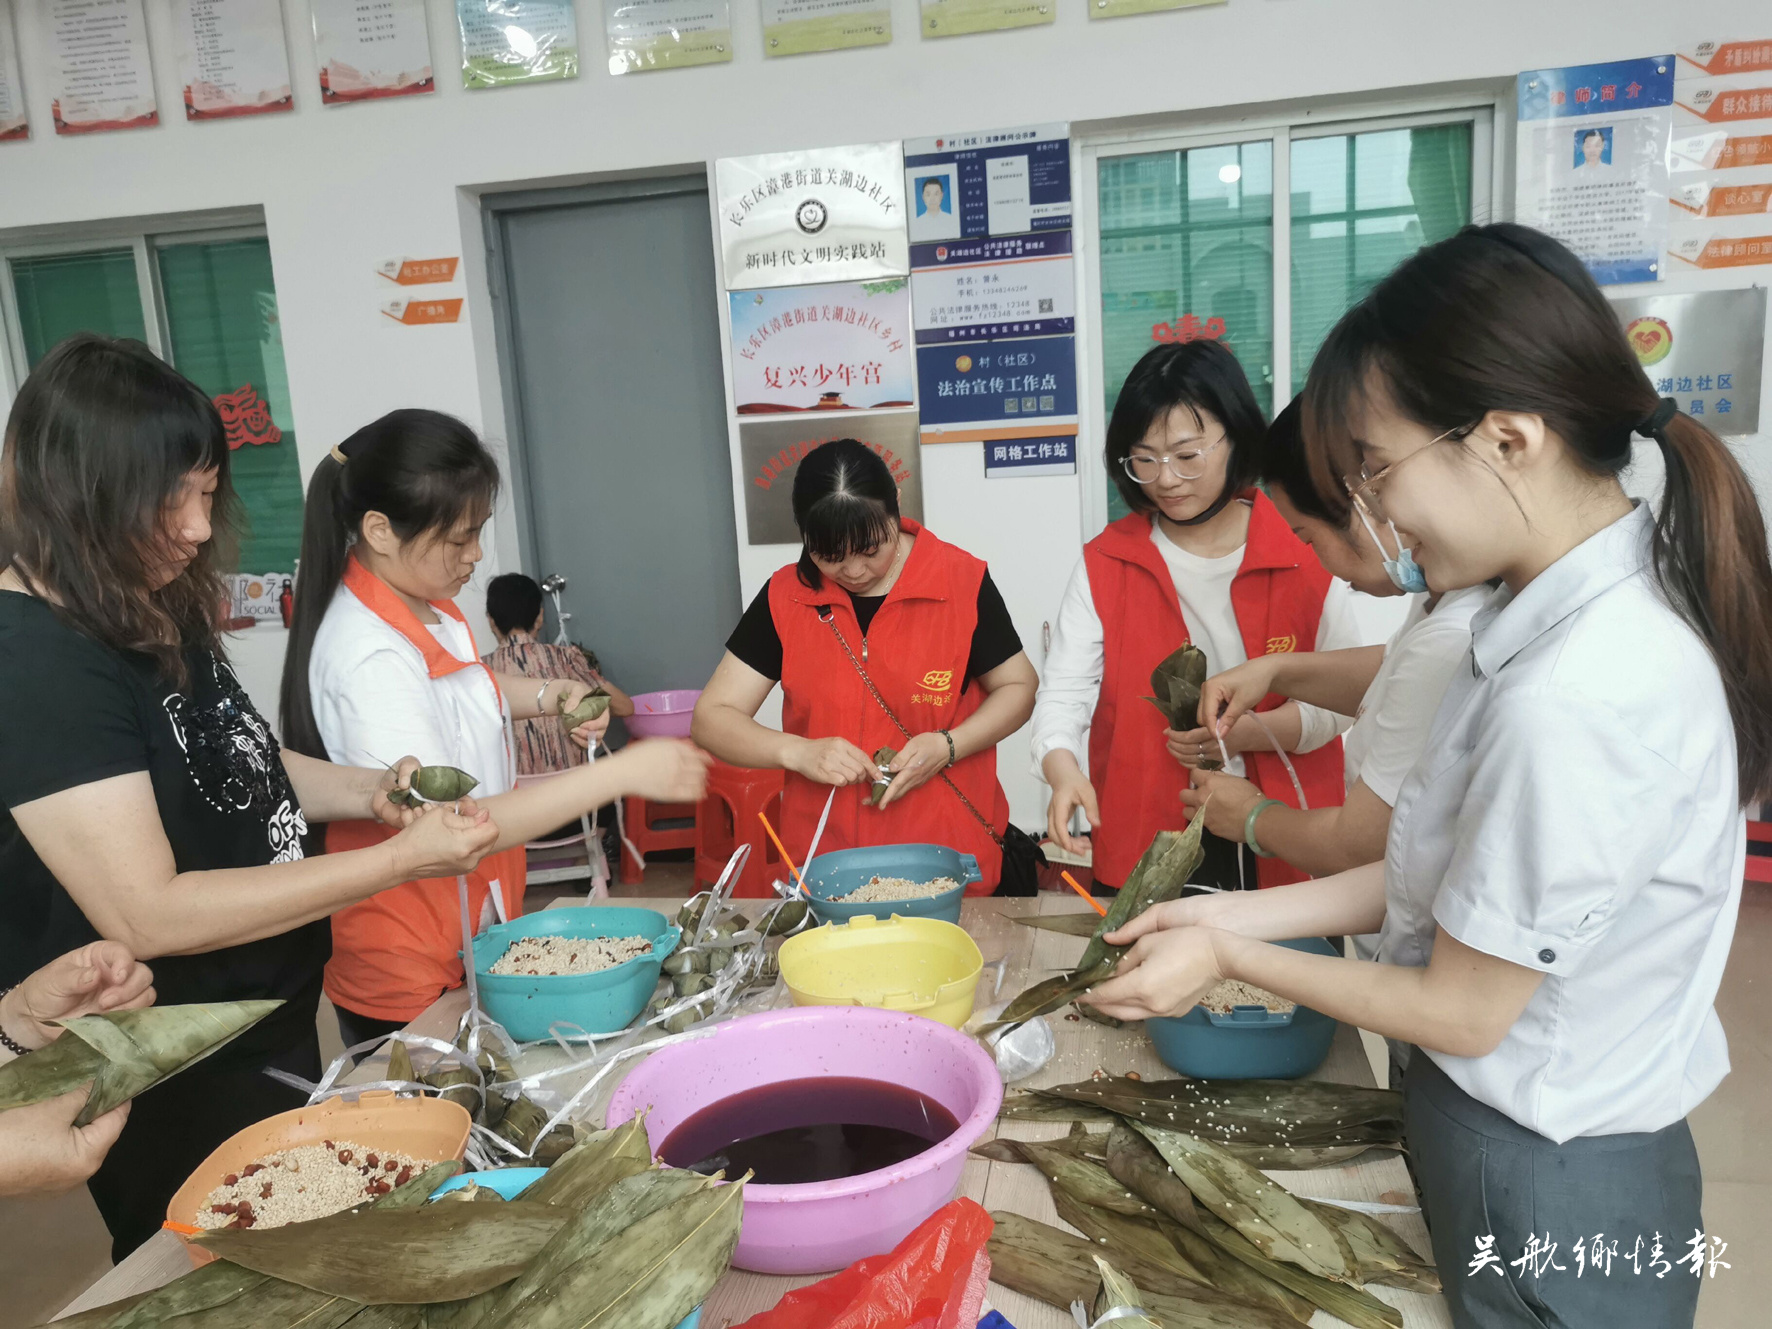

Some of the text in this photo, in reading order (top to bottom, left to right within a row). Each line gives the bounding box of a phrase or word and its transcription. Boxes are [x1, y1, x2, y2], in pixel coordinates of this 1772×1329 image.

[1725, 46, 1772, 67] 矛盾纠纷调
[1550, 82, 1642, 106] 律师简介
[729, 167, 896, 228] 长乐区漳港街道关湖边社区
[1725, 191, 1764, 205] 谈心室
[745, 241, 886, 270] 新时代文明实践站
[979, 353, 1037, 368] 村（社区）
[763, 361, 883, 390] 复兴少年宫
[937, 373, 1057, 397] 法治宣传工作点
[1656, 374, 1733, 393] 湖边社区
[993, 442, 1067, 461] 网格工作站
